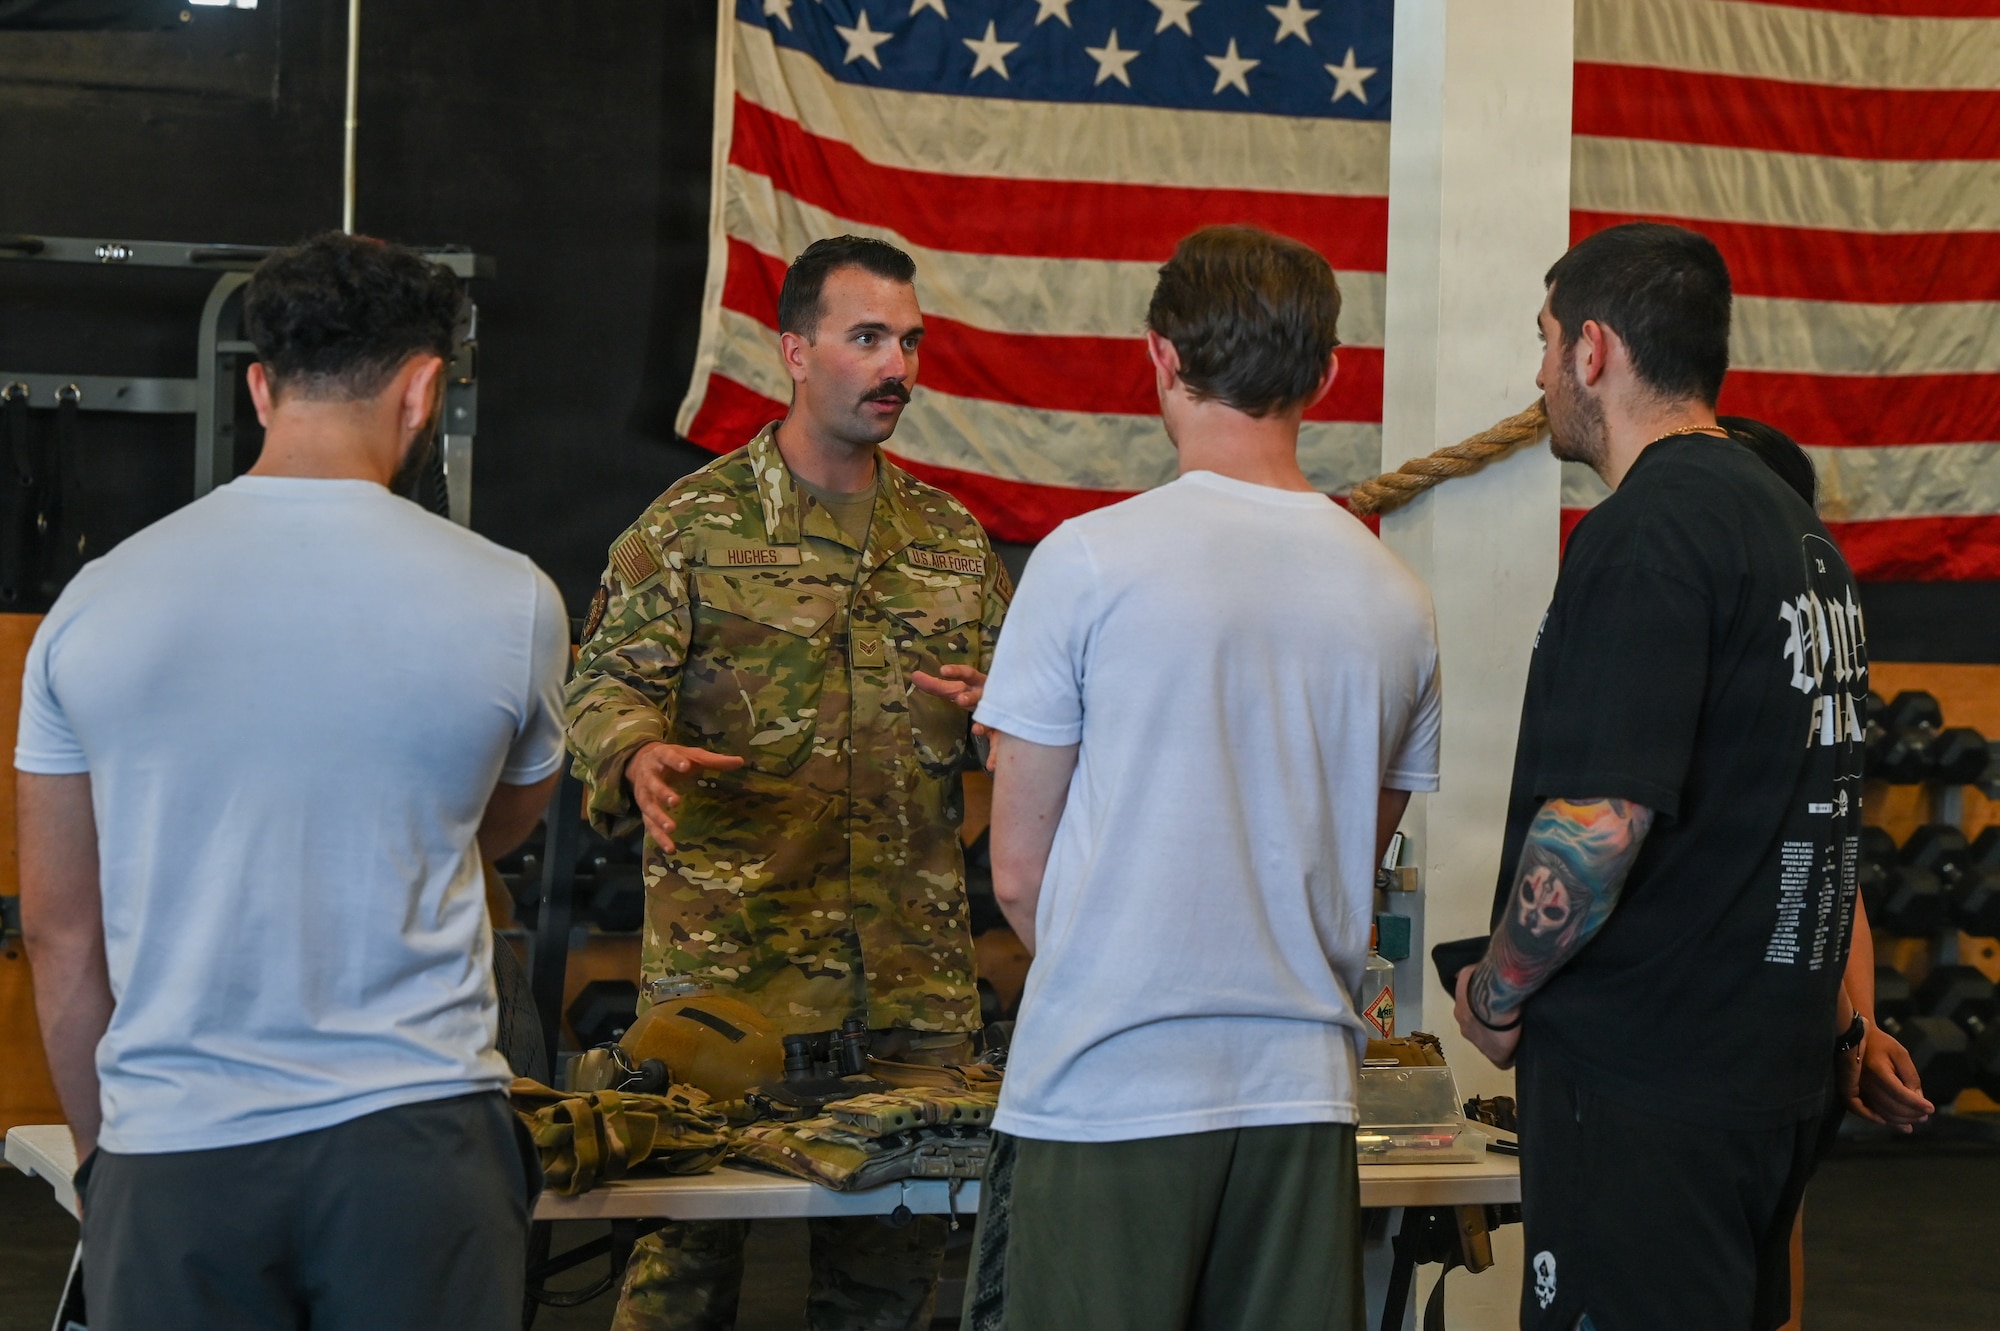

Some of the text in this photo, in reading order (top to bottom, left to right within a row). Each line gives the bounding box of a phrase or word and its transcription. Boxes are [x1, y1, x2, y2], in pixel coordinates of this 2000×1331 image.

[728, 549, 778, 565] HUGHES
[912, 550, 983, 573] U.S. AIR FORCE
